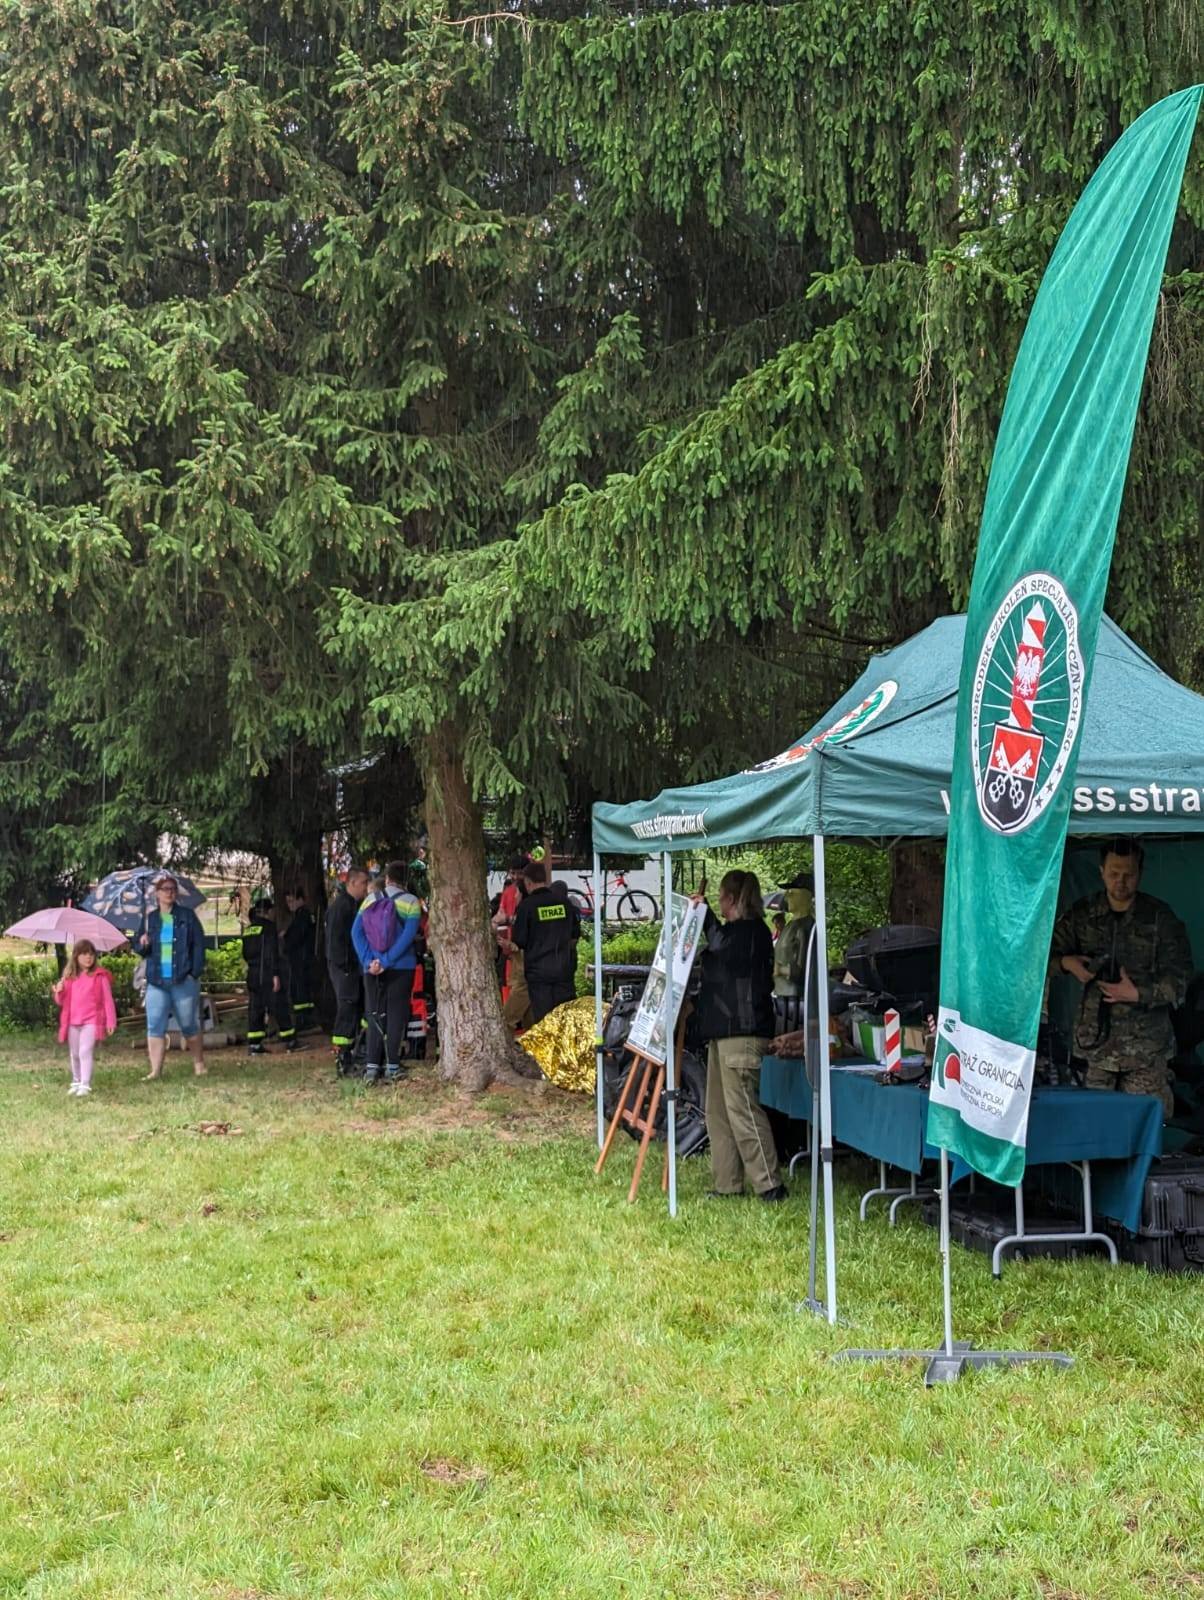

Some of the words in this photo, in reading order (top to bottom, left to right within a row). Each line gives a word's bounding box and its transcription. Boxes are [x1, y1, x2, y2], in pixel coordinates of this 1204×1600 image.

[990, 580, 1028, 642] SZKOLEŃ
[1031, 579, 1081, 721] SPECJALISTYCZNYCH
[1063, 728, 1074, 752] SG
[1073, 782, 1204, 813] ss.stra
[961, 1049, 978, 1072] TRAŻ
